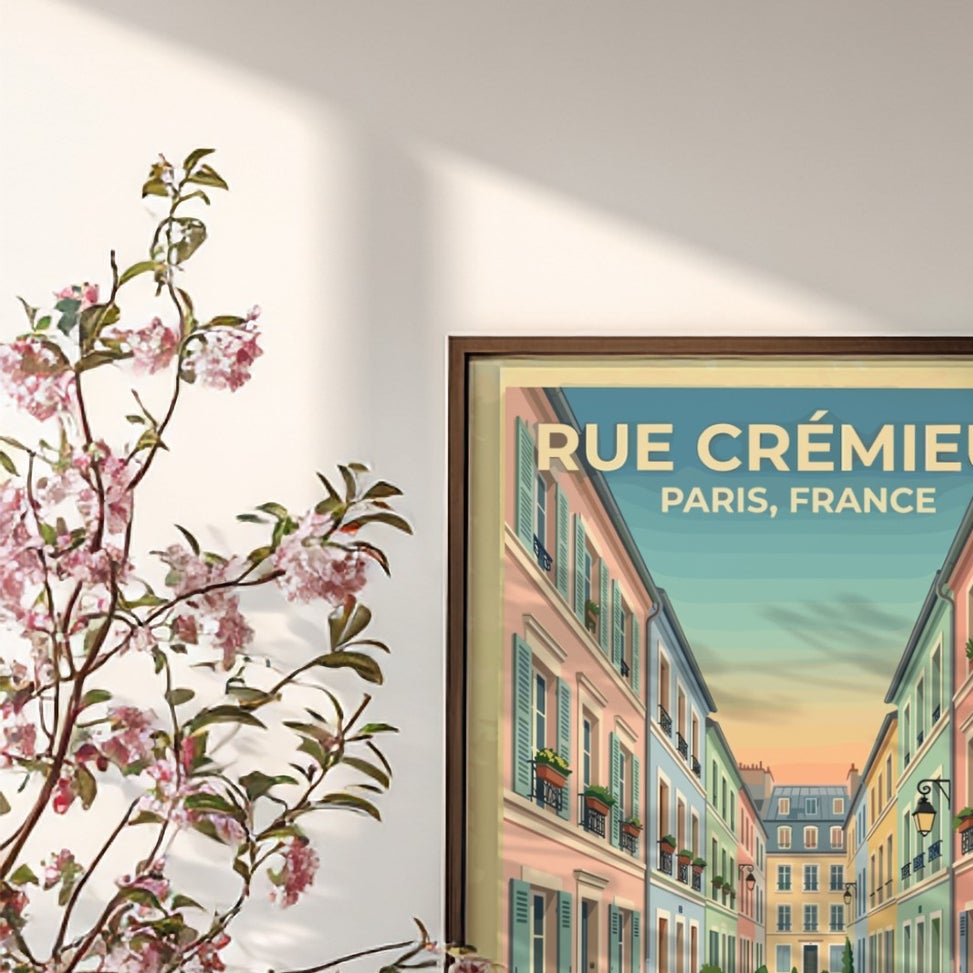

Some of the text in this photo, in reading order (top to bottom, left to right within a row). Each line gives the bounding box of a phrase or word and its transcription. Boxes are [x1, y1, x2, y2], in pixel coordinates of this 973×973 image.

[537, 423, 674, 472] RUE
[660, 486, 937, 518] PARIS, FRANCE
